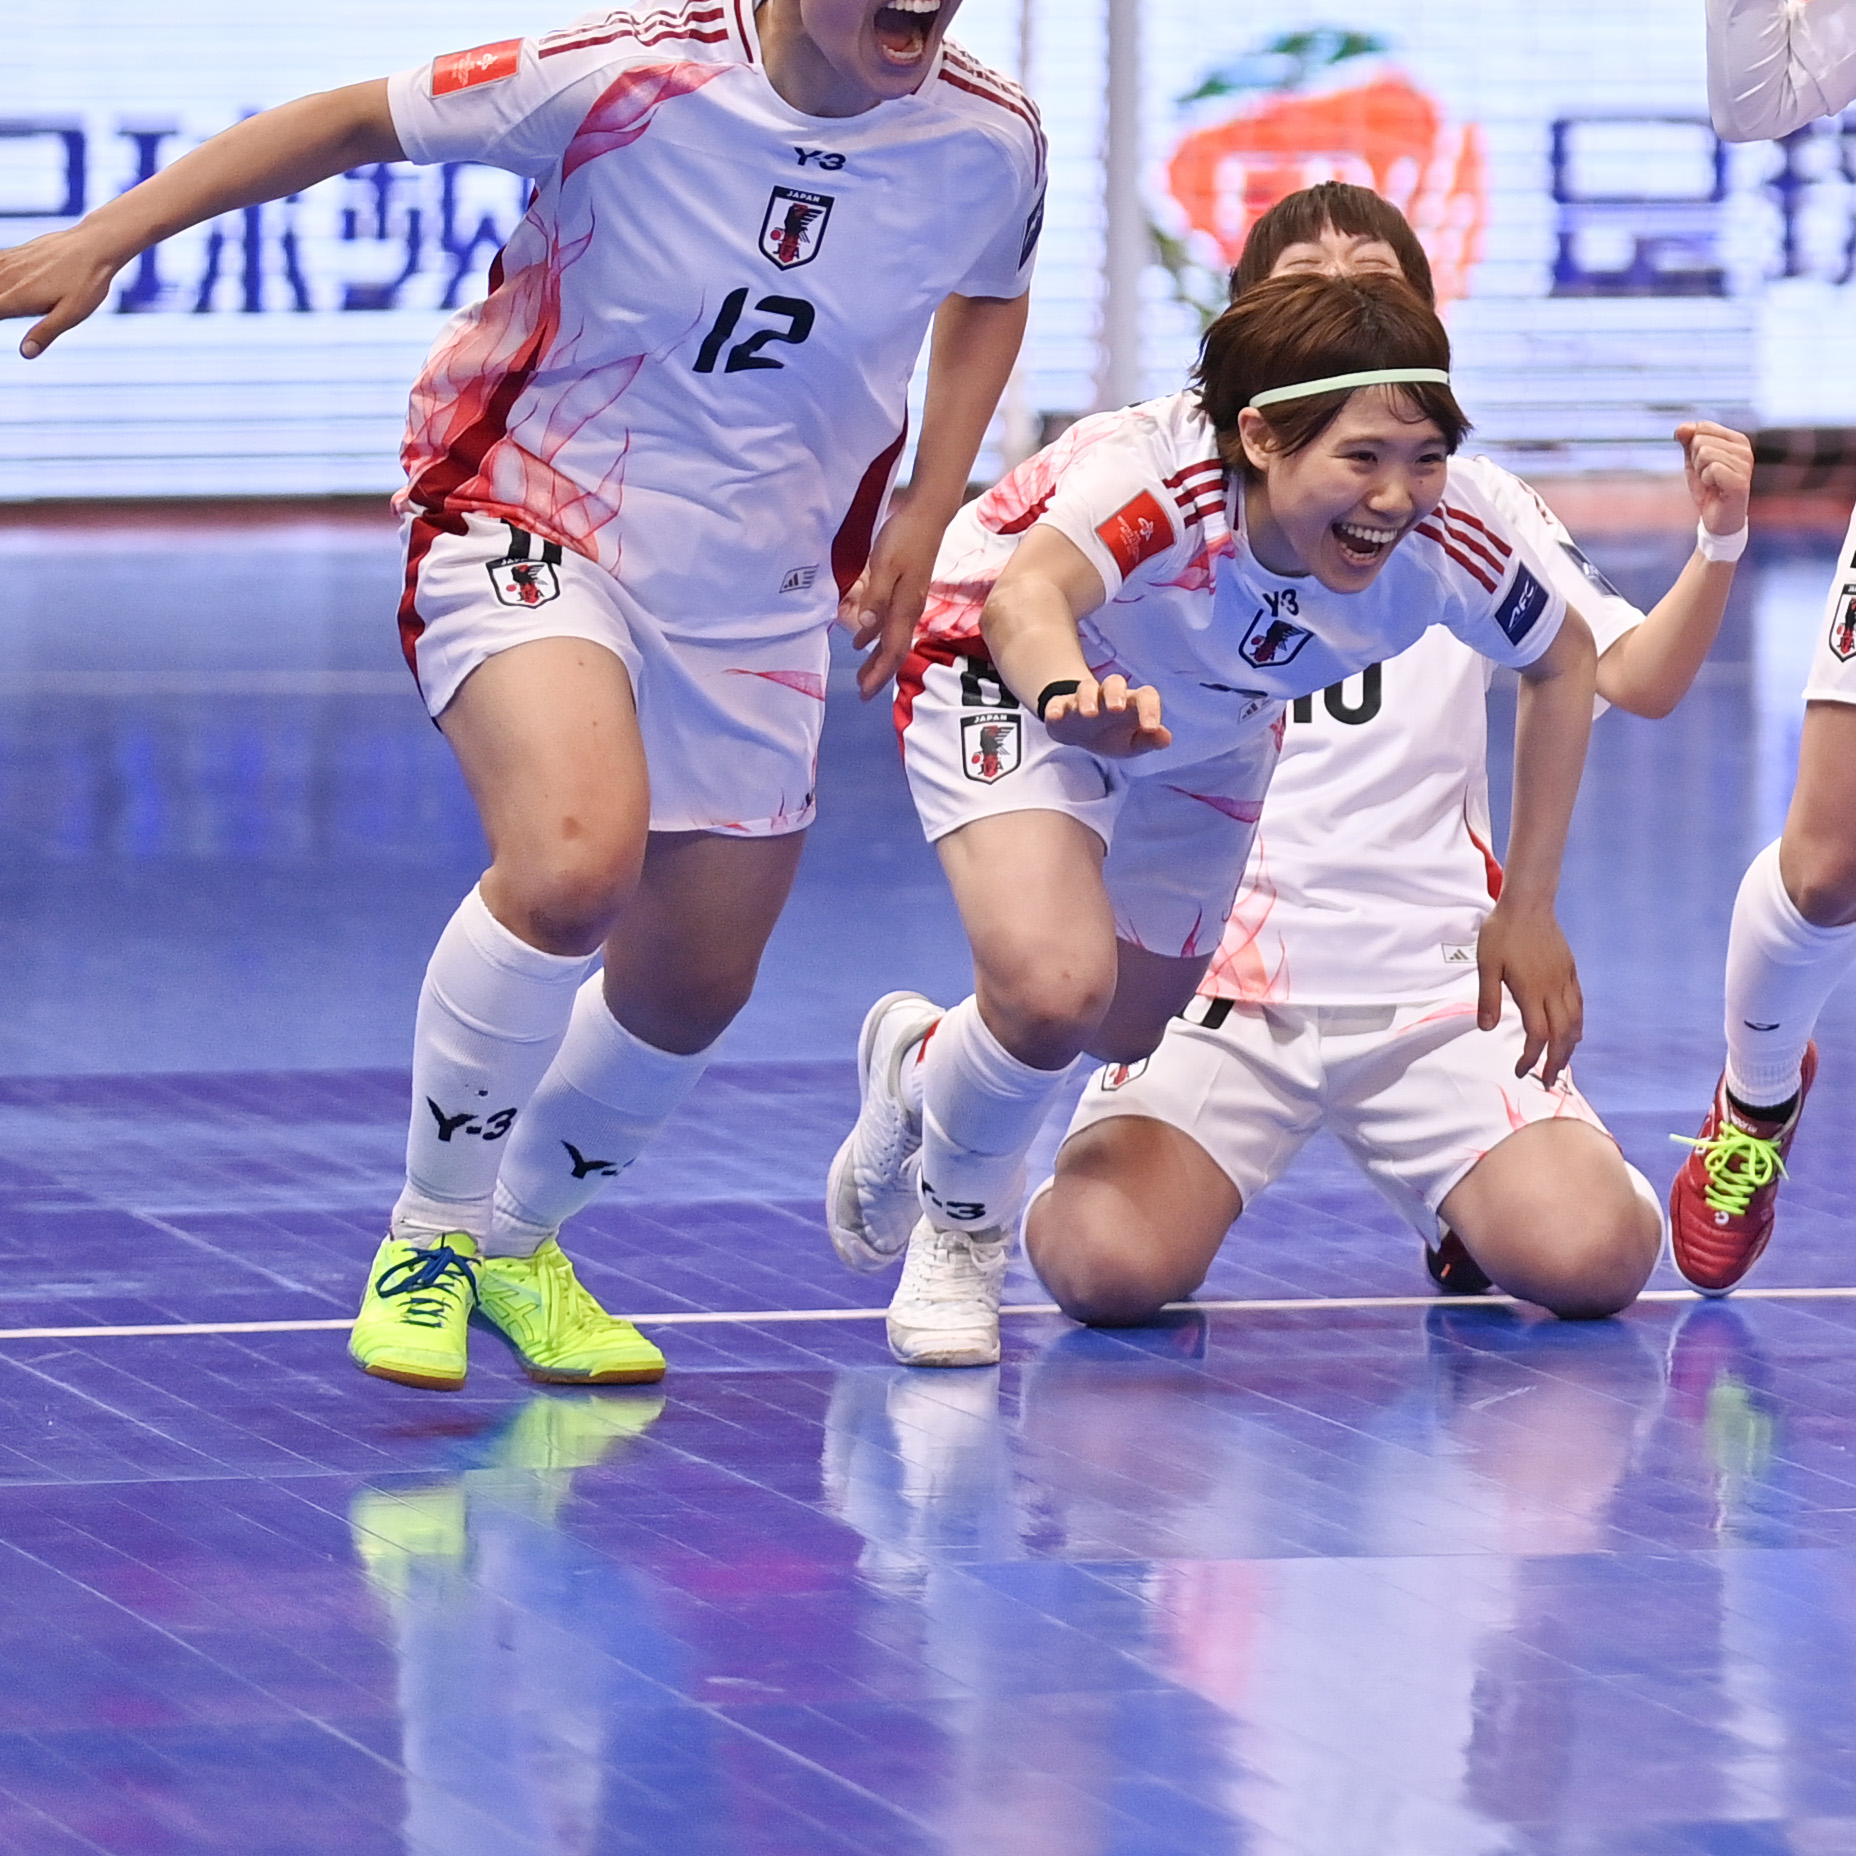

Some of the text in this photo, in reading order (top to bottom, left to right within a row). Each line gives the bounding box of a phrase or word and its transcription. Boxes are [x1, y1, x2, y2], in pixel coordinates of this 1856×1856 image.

[793, 146, 847, 172] Y-3
[786, 189, 821, 204] JAPAN
[692, 286, 816, 374] 12
[1263, 587, 1300, 618] Y-3
[1506, 579, 1536, 631] AFC
[973, 713, 1008, 724] JAPAN
[426, 1095, 518, 1142] Y-3
